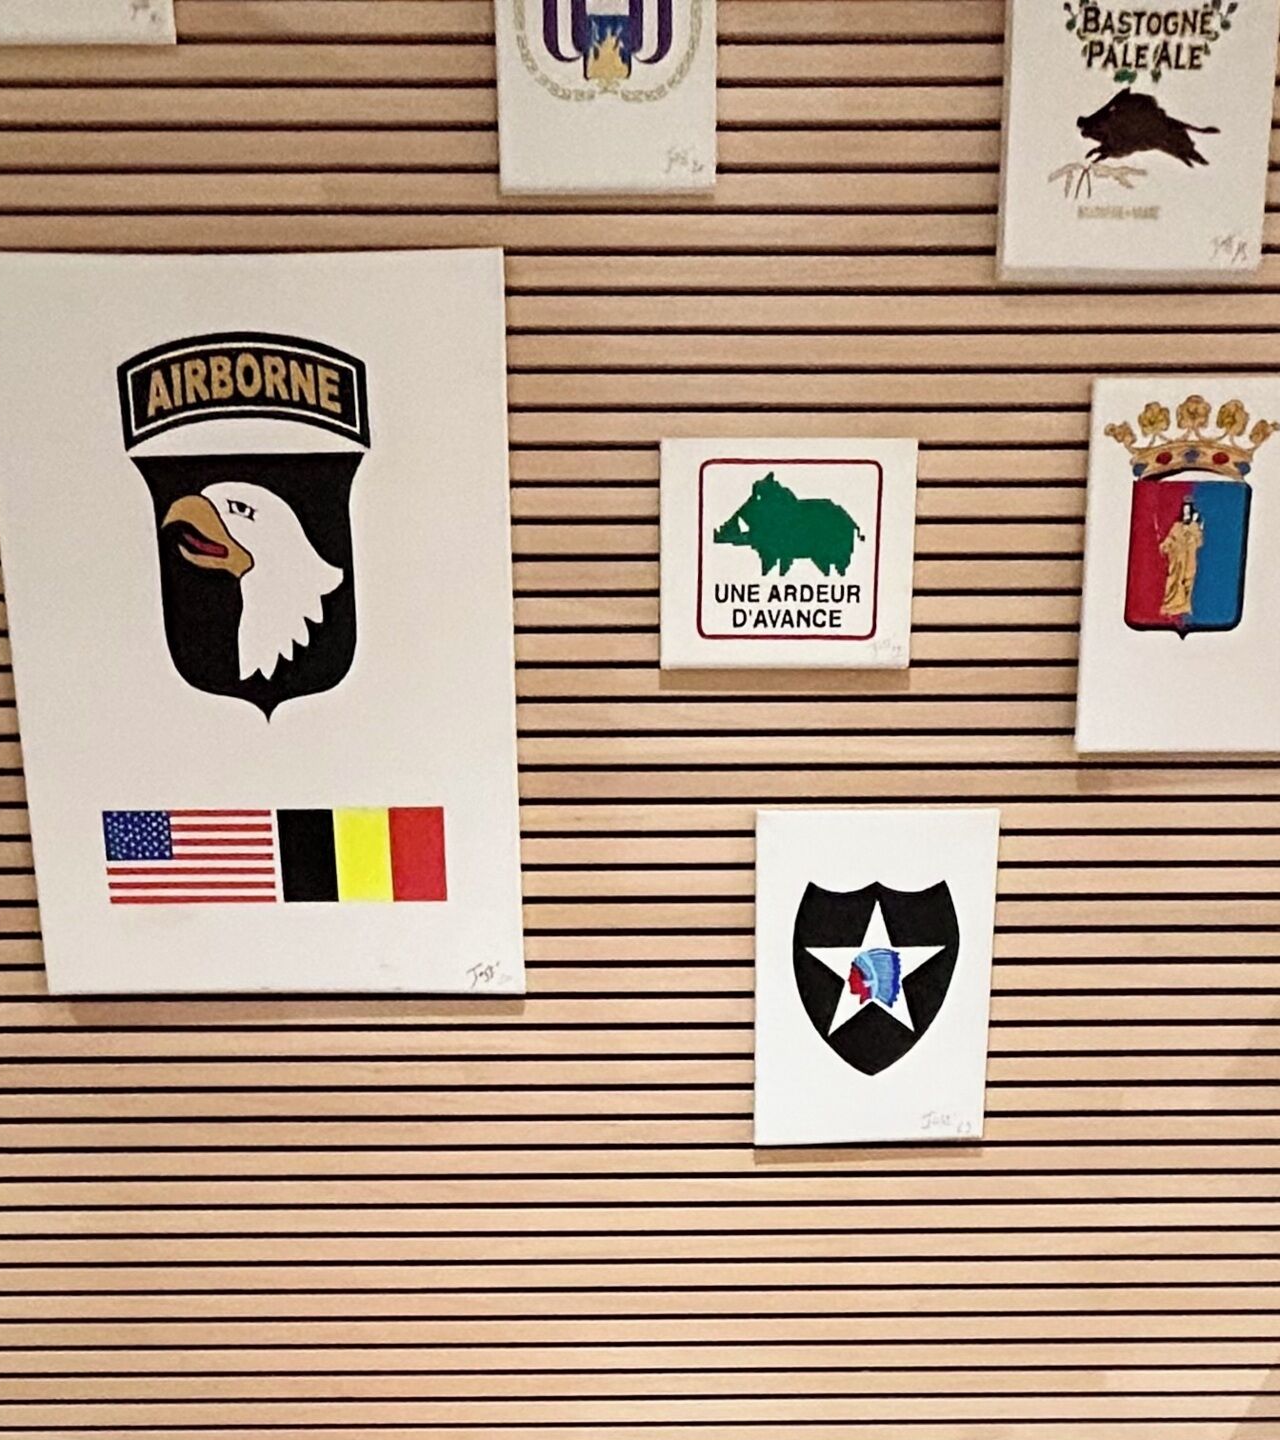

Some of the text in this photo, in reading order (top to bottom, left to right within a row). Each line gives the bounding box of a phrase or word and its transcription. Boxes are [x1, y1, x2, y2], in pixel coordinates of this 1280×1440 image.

[1082, 6, 1214, 35] BASTOGNE
[1086, 40, 1203, 69] PALE ALE
[147, 352, 342, 417] AIRBORNE
[714, 584, 861, 603] UNE ARDEUR
[732, 609, 843, 628] D'AVANCE
